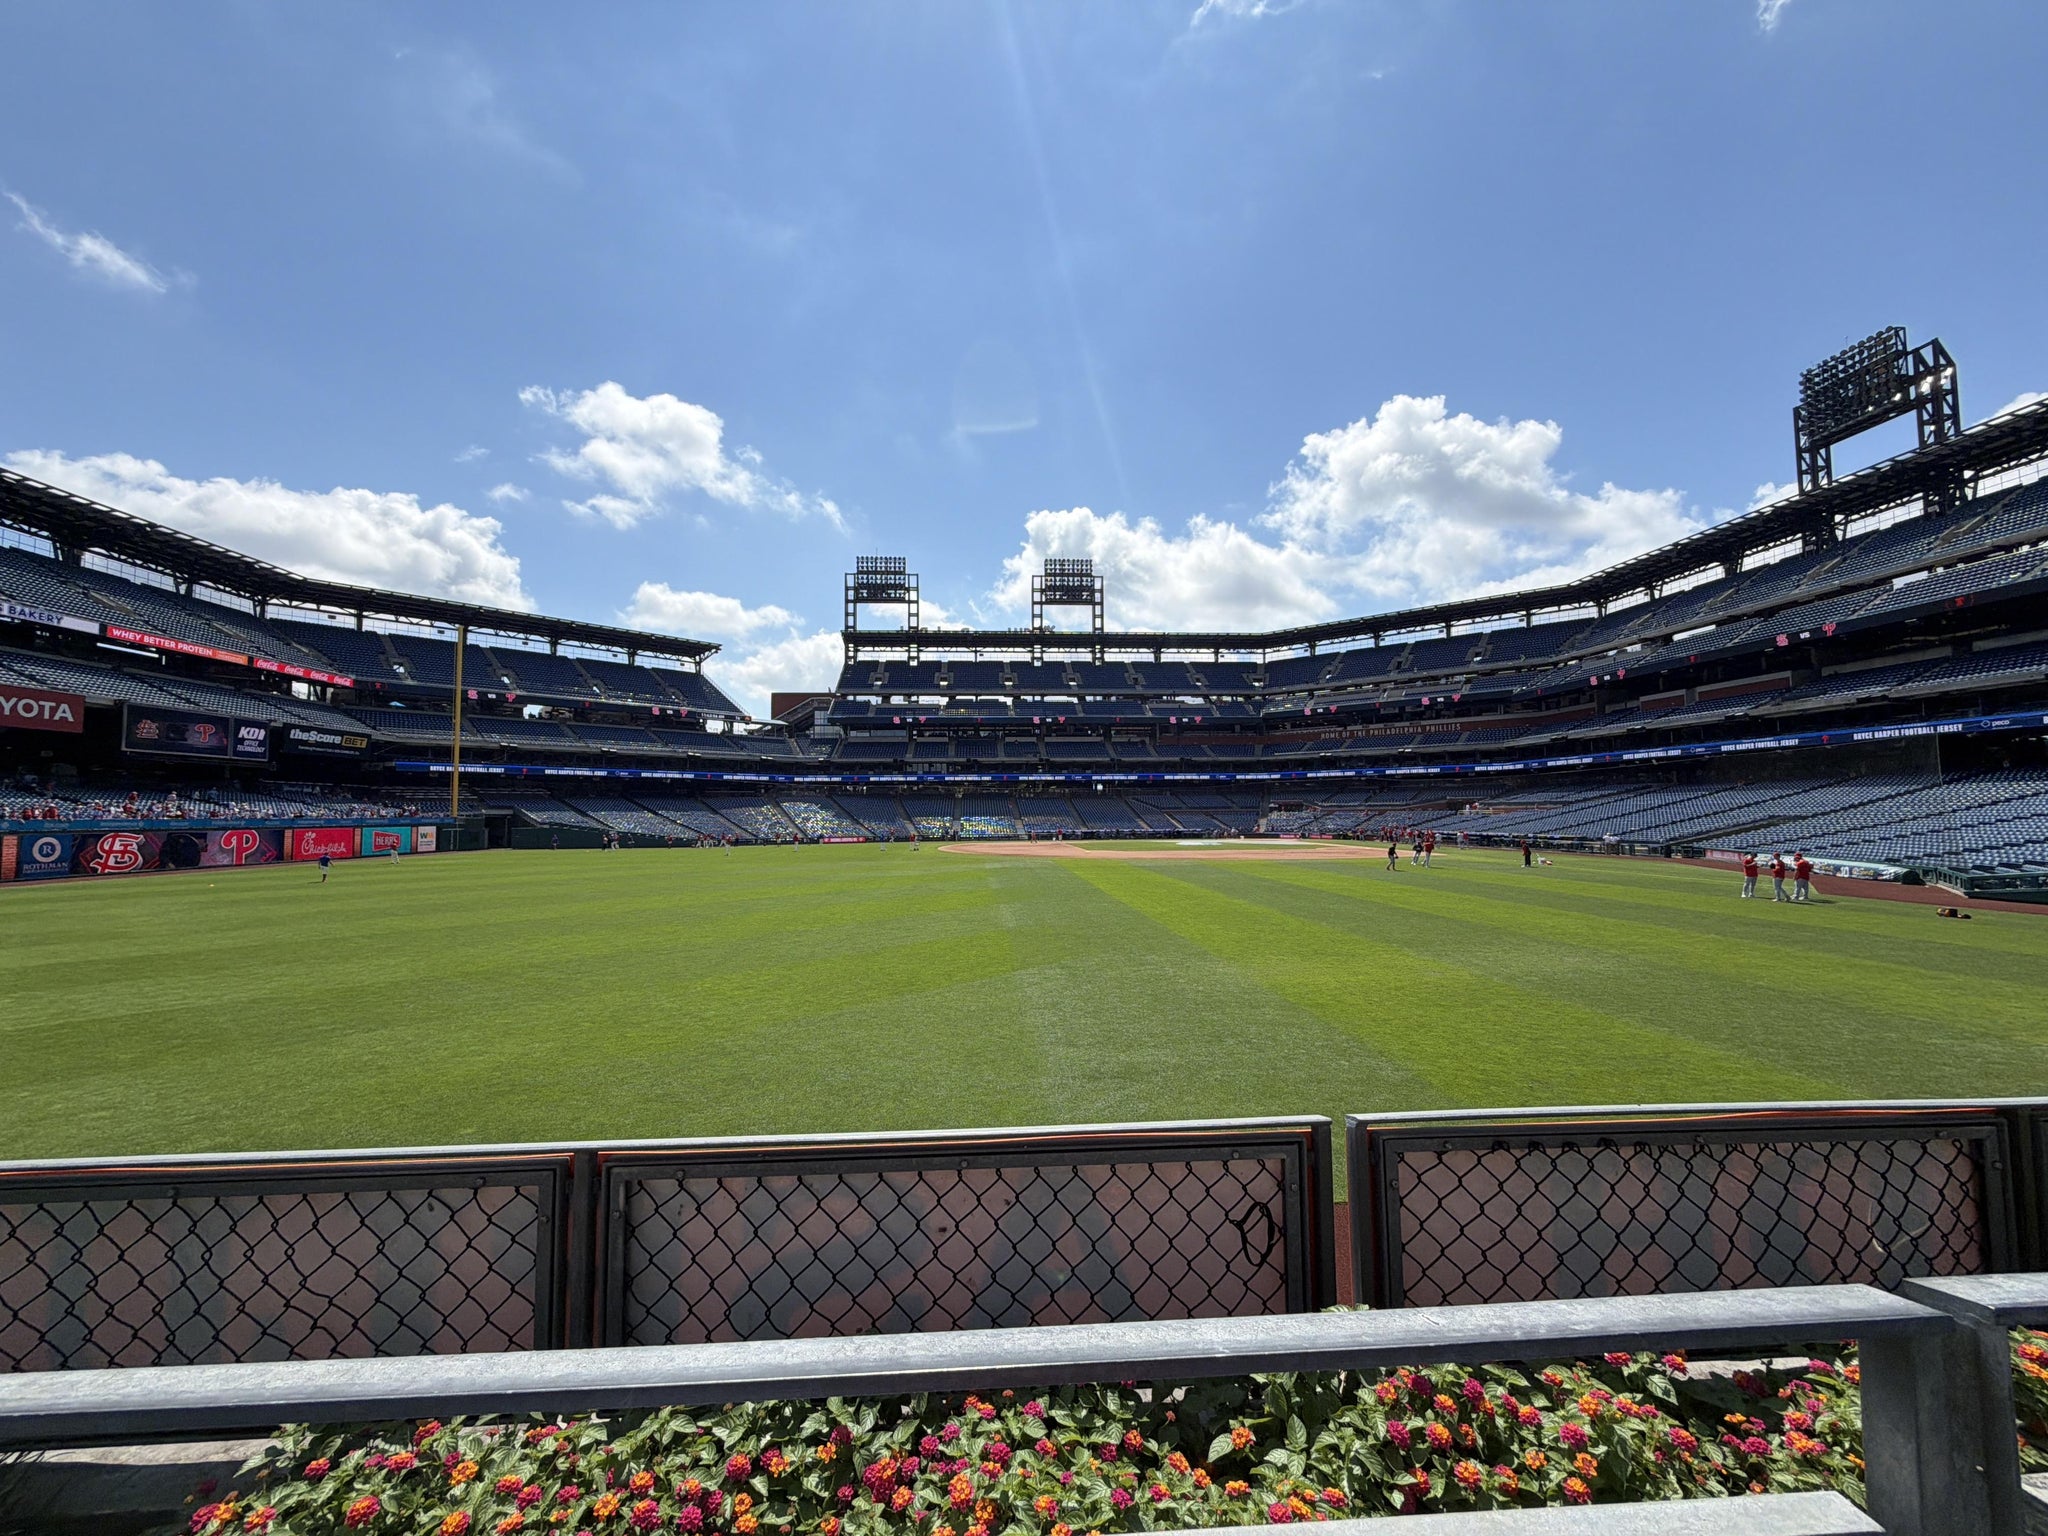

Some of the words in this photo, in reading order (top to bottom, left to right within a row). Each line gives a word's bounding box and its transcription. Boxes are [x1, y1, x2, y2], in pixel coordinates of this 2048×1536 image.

[8, 605, 64, 625] BAKERY
[112, 628, 142, 641] WHEY
[143, 635, 176, 649] BETTER
[177, 642, 213, 656] PROTEIN
[289, 728, 342, 744] theScore
[344, 737, 367, 747] BET
[1369, 726, 1422, 736] PHILADELPHIA
[1425, 723, 1461, 732] PHILLIES
[1901, 726, 1934, 736] FOOTBALL
[1936, 723, 1963, 733] JERSEY
[42, 844, 54, 855] R
[221, 829, 260, 865] P
[22, 861, 69, 870] ROTHMAN
